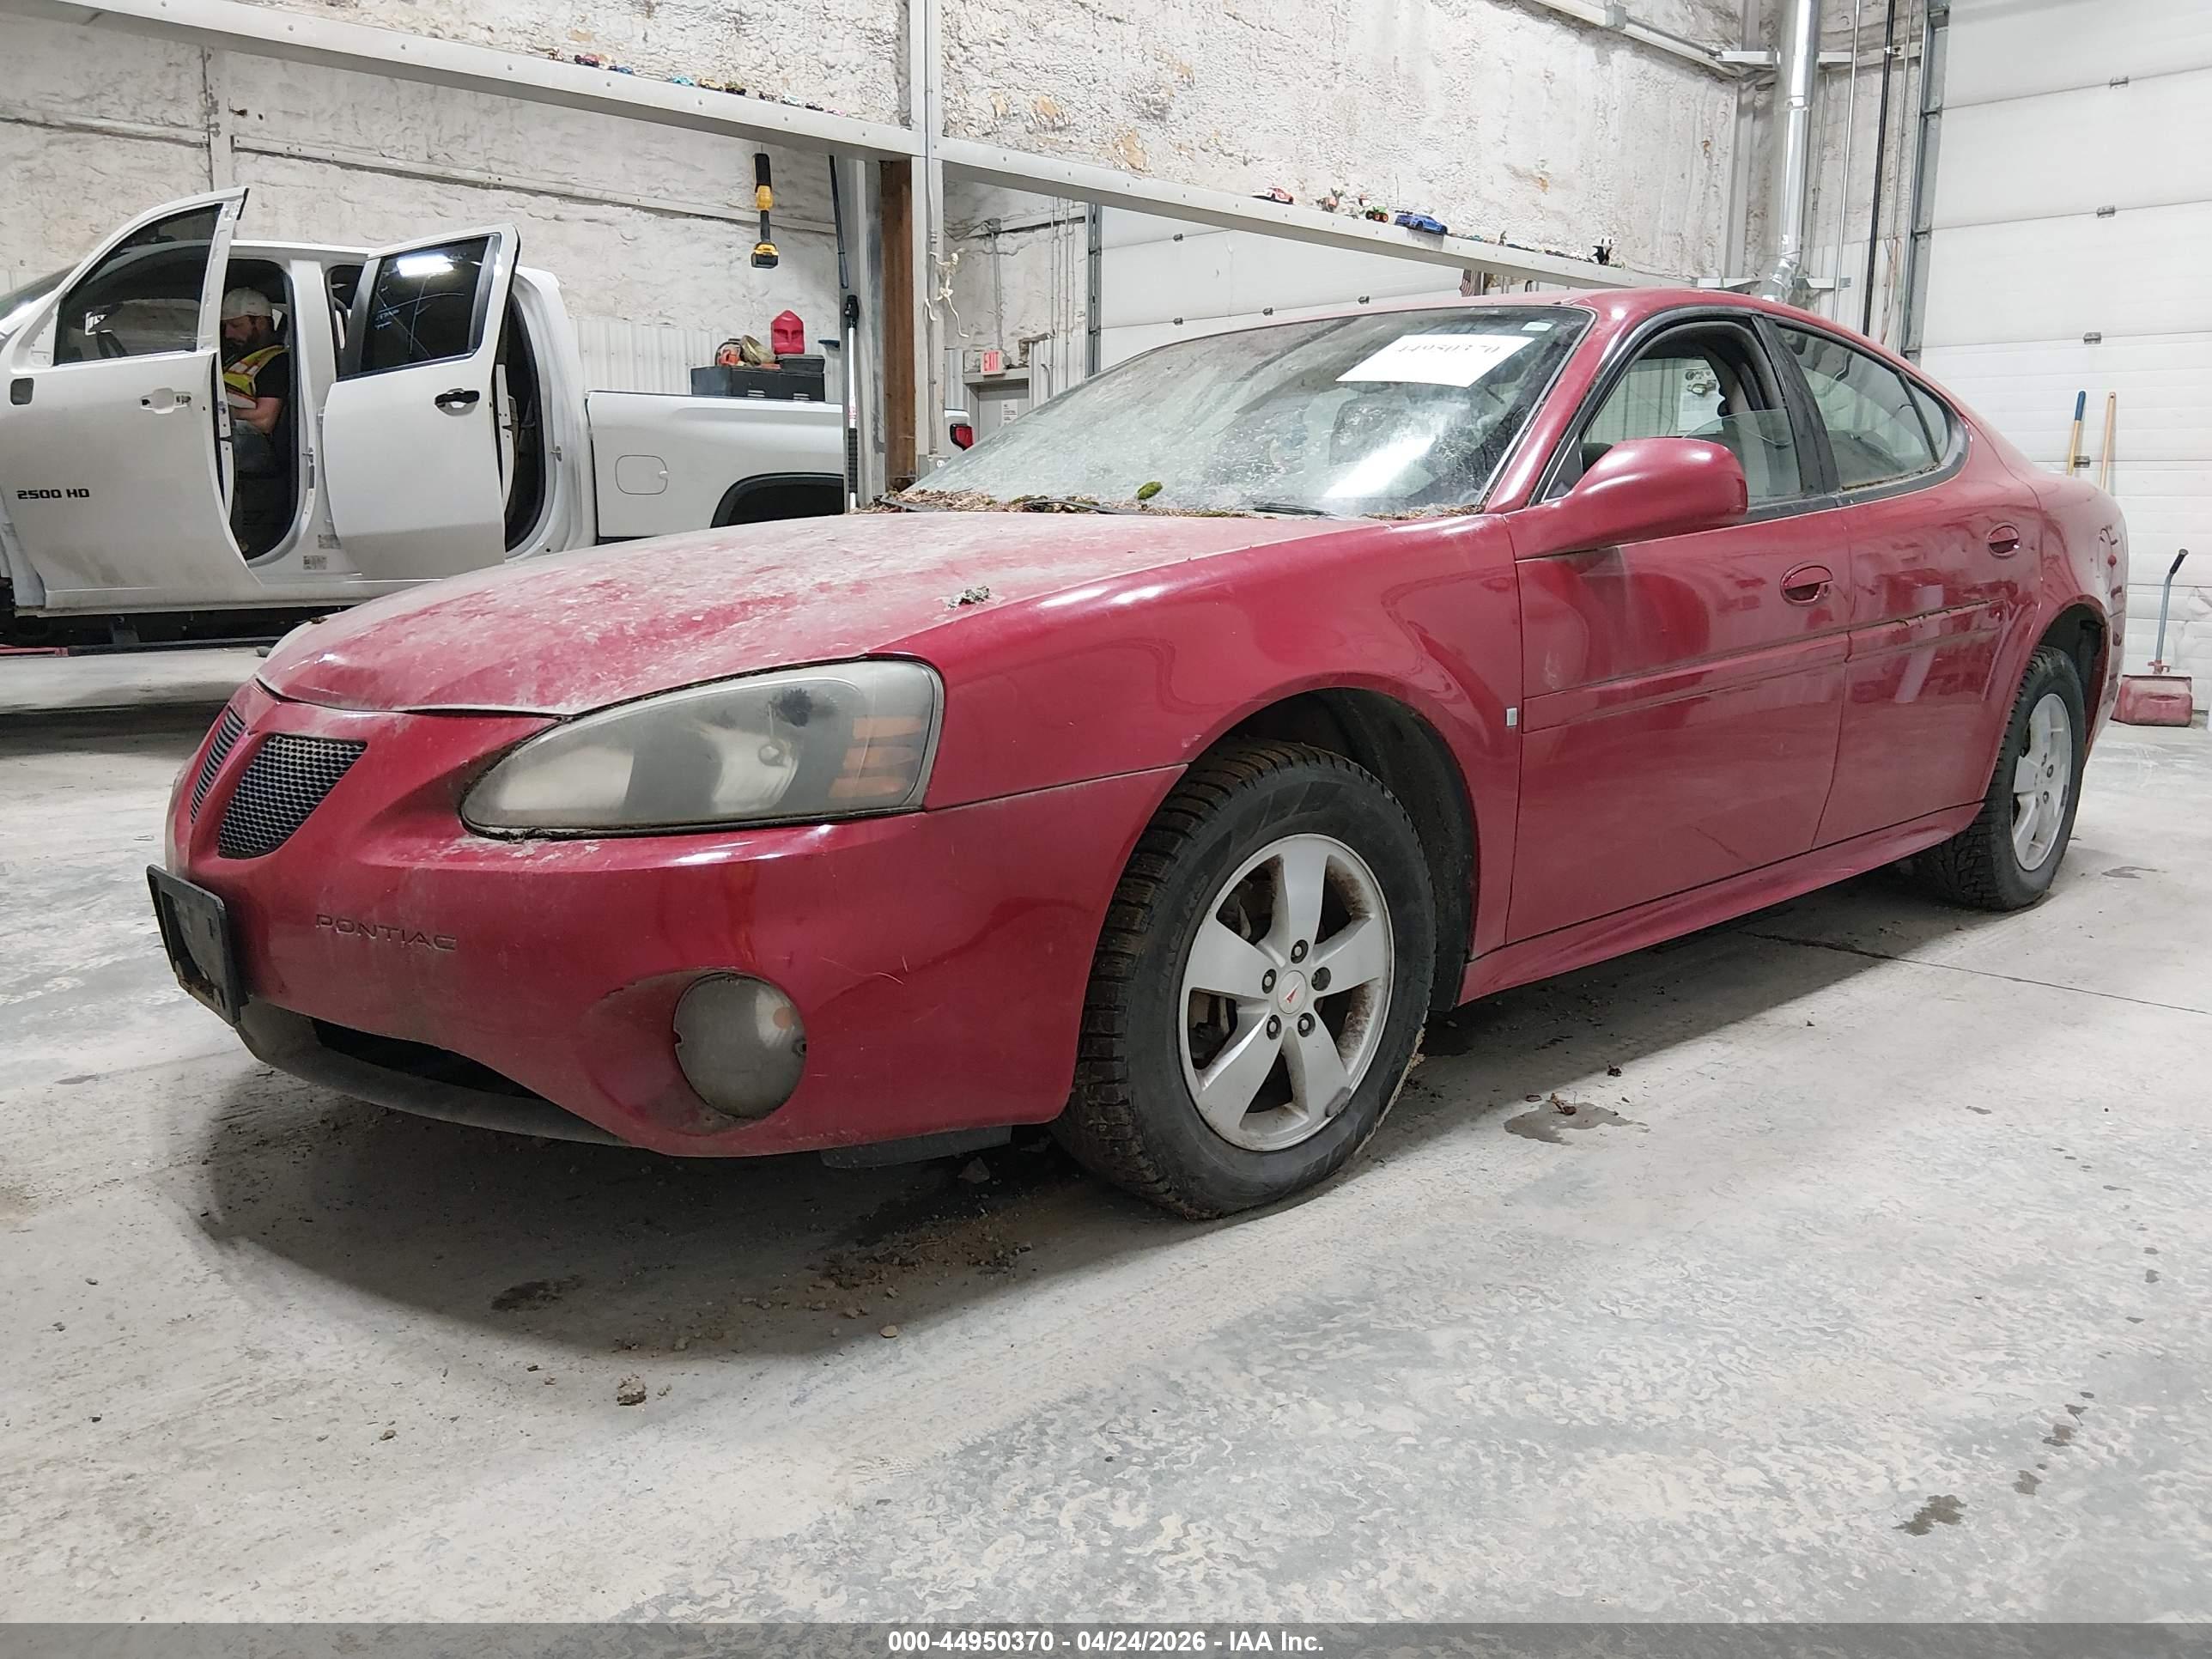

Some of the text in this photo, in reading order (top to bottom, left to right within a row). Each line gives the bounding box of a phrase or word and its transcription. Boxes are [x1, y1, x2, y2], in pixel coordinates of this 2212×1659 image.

[16, 488, 90, 500] 2500 HD
[315, 913, 457, 952] PONTIAC
